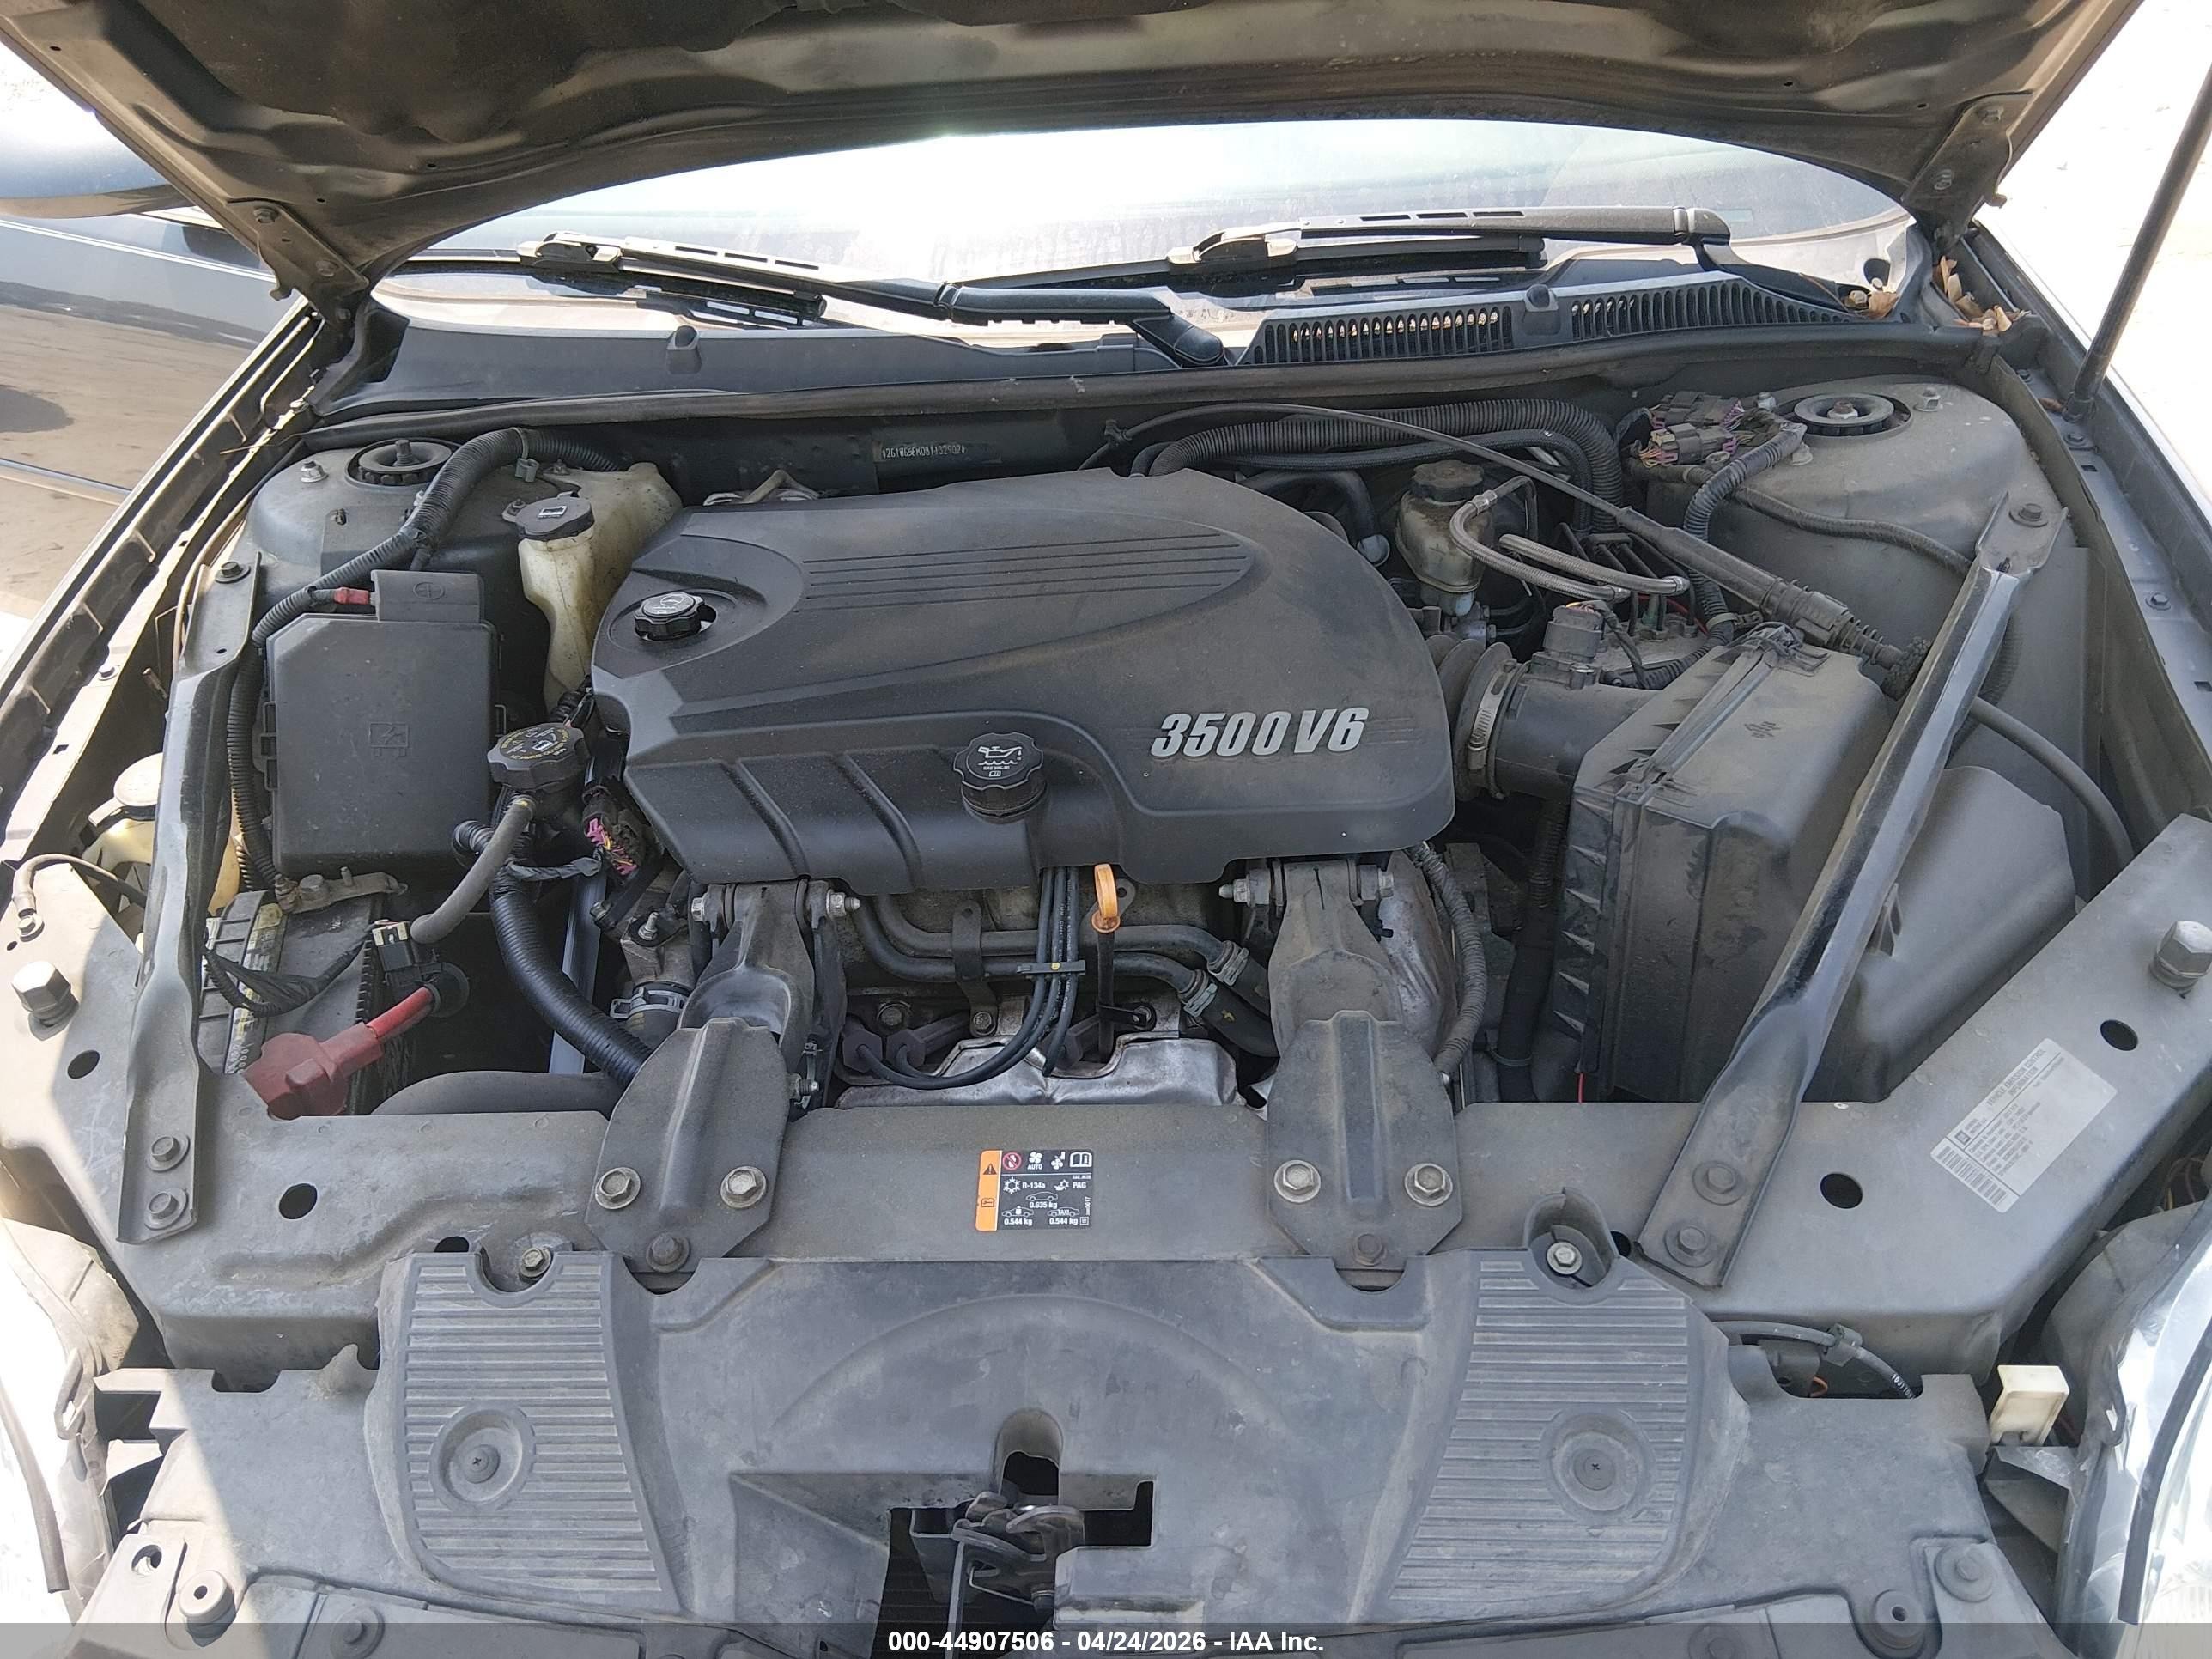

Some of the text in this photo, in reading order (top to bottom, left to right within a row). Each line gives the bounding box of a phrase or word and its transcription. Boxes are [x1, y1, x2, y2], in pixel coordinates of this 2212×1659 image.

[1150, 707, 1370, 757] 3500 V6
[1068, 1217, 1079, 1226] kg
